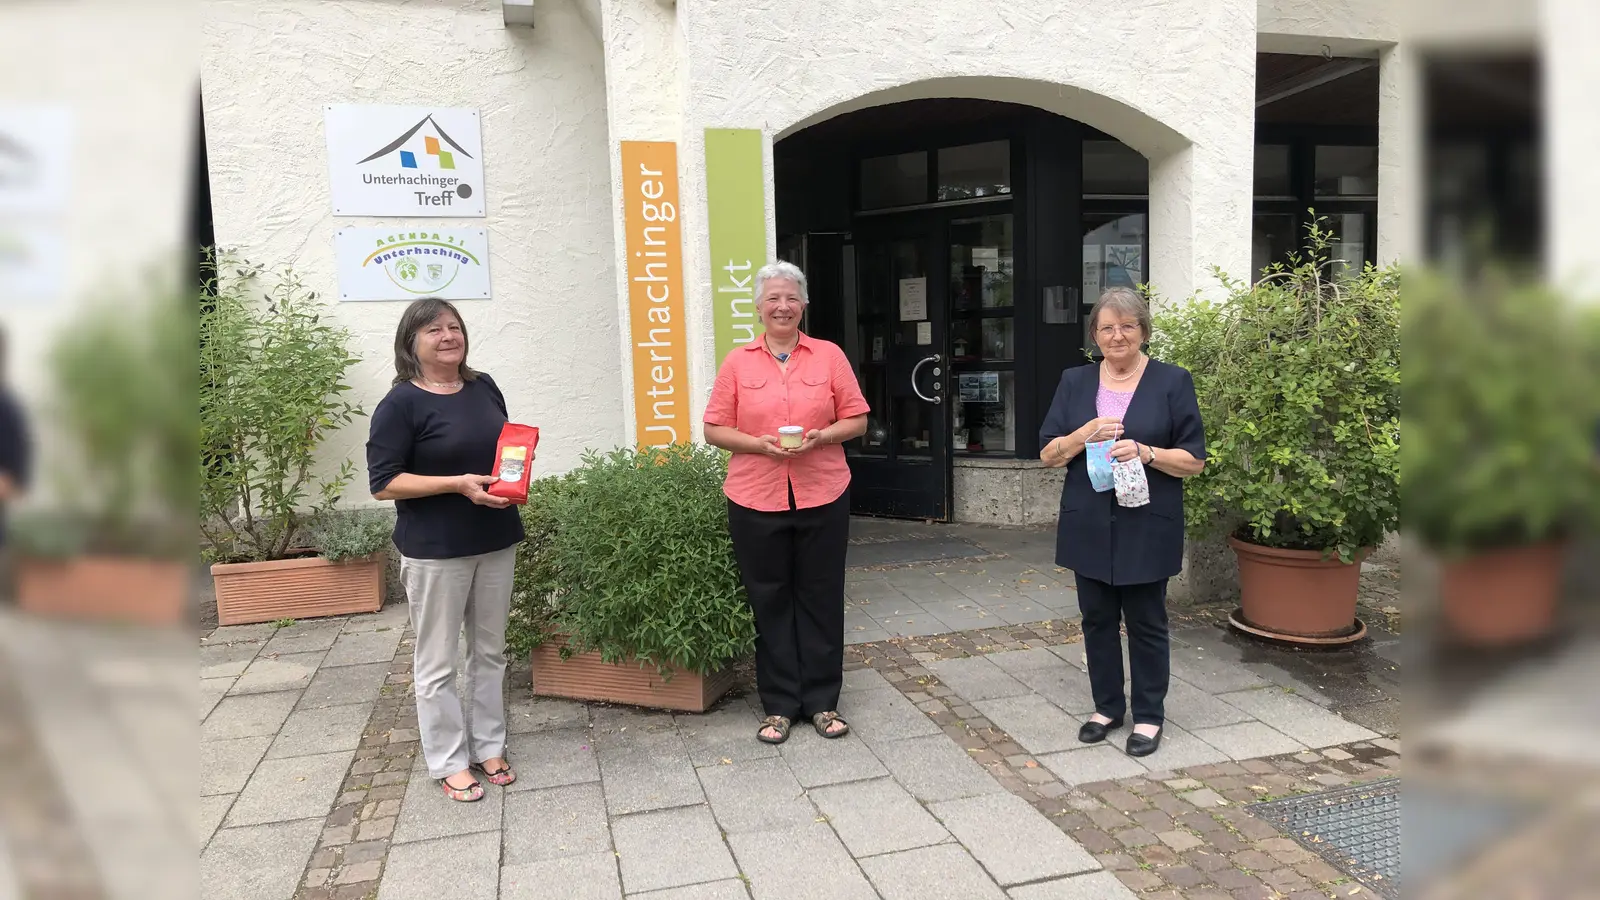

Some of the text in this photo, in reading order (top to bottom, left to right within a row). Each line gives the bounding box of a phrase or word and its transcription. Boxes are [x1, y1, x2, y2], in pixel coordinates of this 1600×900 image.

[363, 174, 458, 188] Unterhachinger
[414, 191, 454, 206] Treff
[376, 232, 440, 247] AGENDA
[373, 247, 469, 264] Unterhaching
[634, 163, 676, 449] Unterhachinger
[717, 259, 756, 343] unkt
